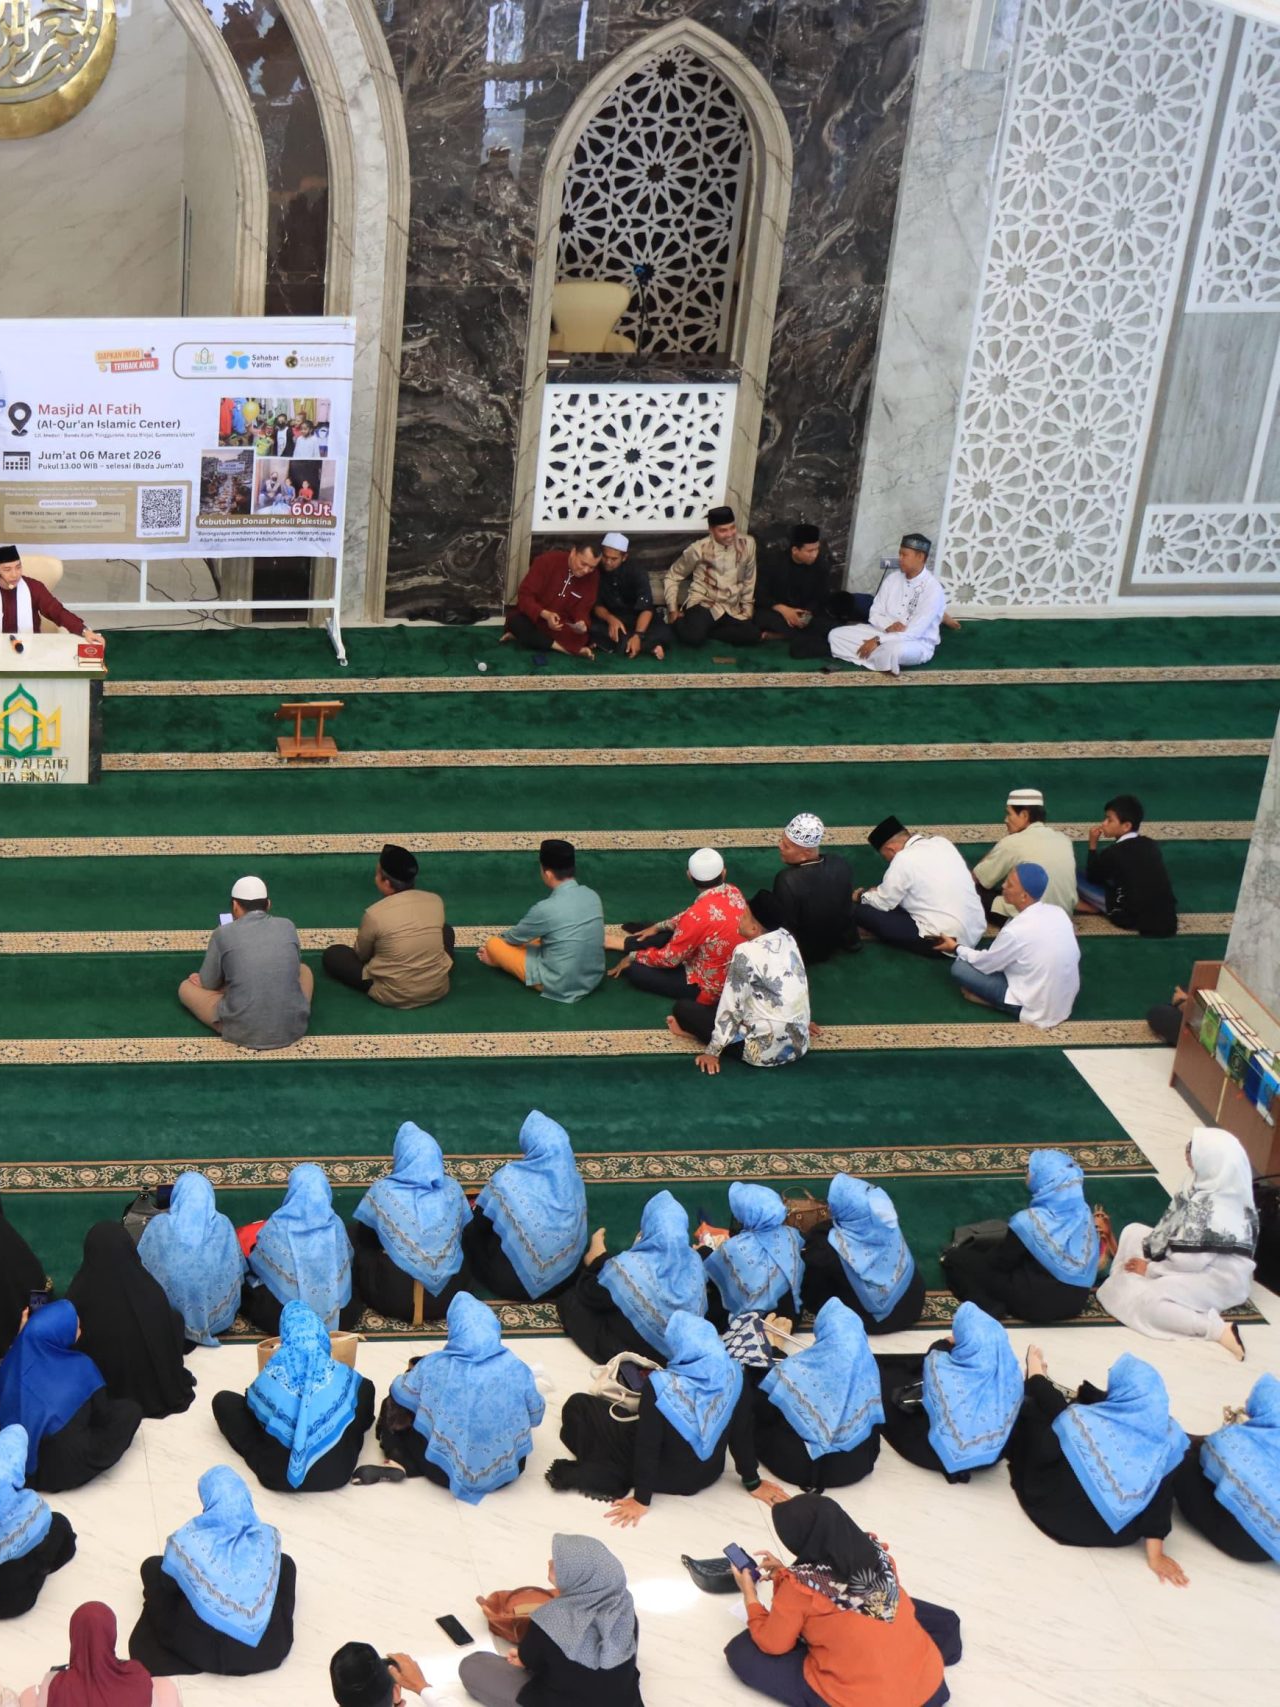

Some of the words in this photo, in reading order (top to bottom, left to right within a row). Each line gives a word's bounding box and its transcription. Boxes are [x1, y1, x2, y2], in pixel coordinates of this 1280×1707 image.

[38, 403, 84, 418] Masjid
[88, 403, 102, 415] Al
[106, 403, 142, 415] Fatih
[37, 419, 94, 430] (Al-Qur'an
[97, 419, 136, 429] Islamic
[139, 419, 181, 430] Center)
[38, 451, 76, 460] Jum'at
[79, 451, 95, 460] 06
[98, 451, 131, 460] Maret
[133, 450, 162, 459] 2026
[106, 462, 132, 470] selesai
[133, 462, 155, 470] (Bada
[156, 462, 184, 470] Jum'at)
[292, 502, 332, 516] 60Jt
[199, 517, 241, 526] Kebutuhan
[242, 517, 269, 525] Donasi
[270, 517, 295, 525] Peduli
[296, 517, 332, 526] Palestina
[36, 758, 69, 769] FATIH
[20, 771, 59, 783] BINJAI
